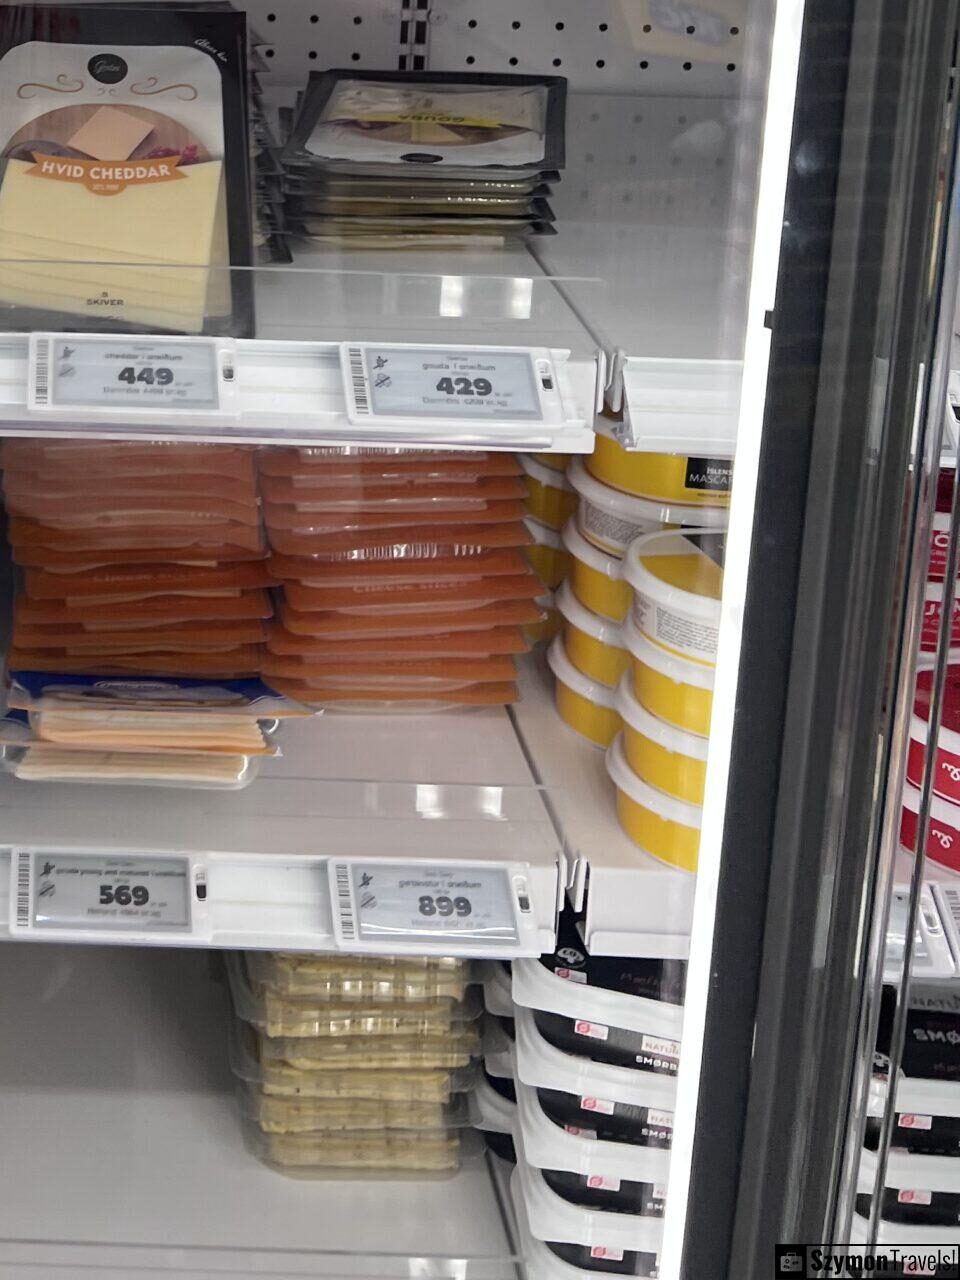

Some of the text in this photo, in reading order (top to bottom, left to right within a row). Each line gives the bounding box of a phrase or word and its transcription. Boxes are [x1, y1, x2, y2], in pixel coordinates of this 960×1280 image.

[42, 160, 171, 180] HVID CHEDDAR
[85, 298, 124, 306] SKIVER
[118, 366, 174, 386] 449
[436, 377, 493, 396] 429
[99, 885, 150, 906] 569
[418, 895, 472, 917] 899
[646, 1202, 665, 1210] SM
